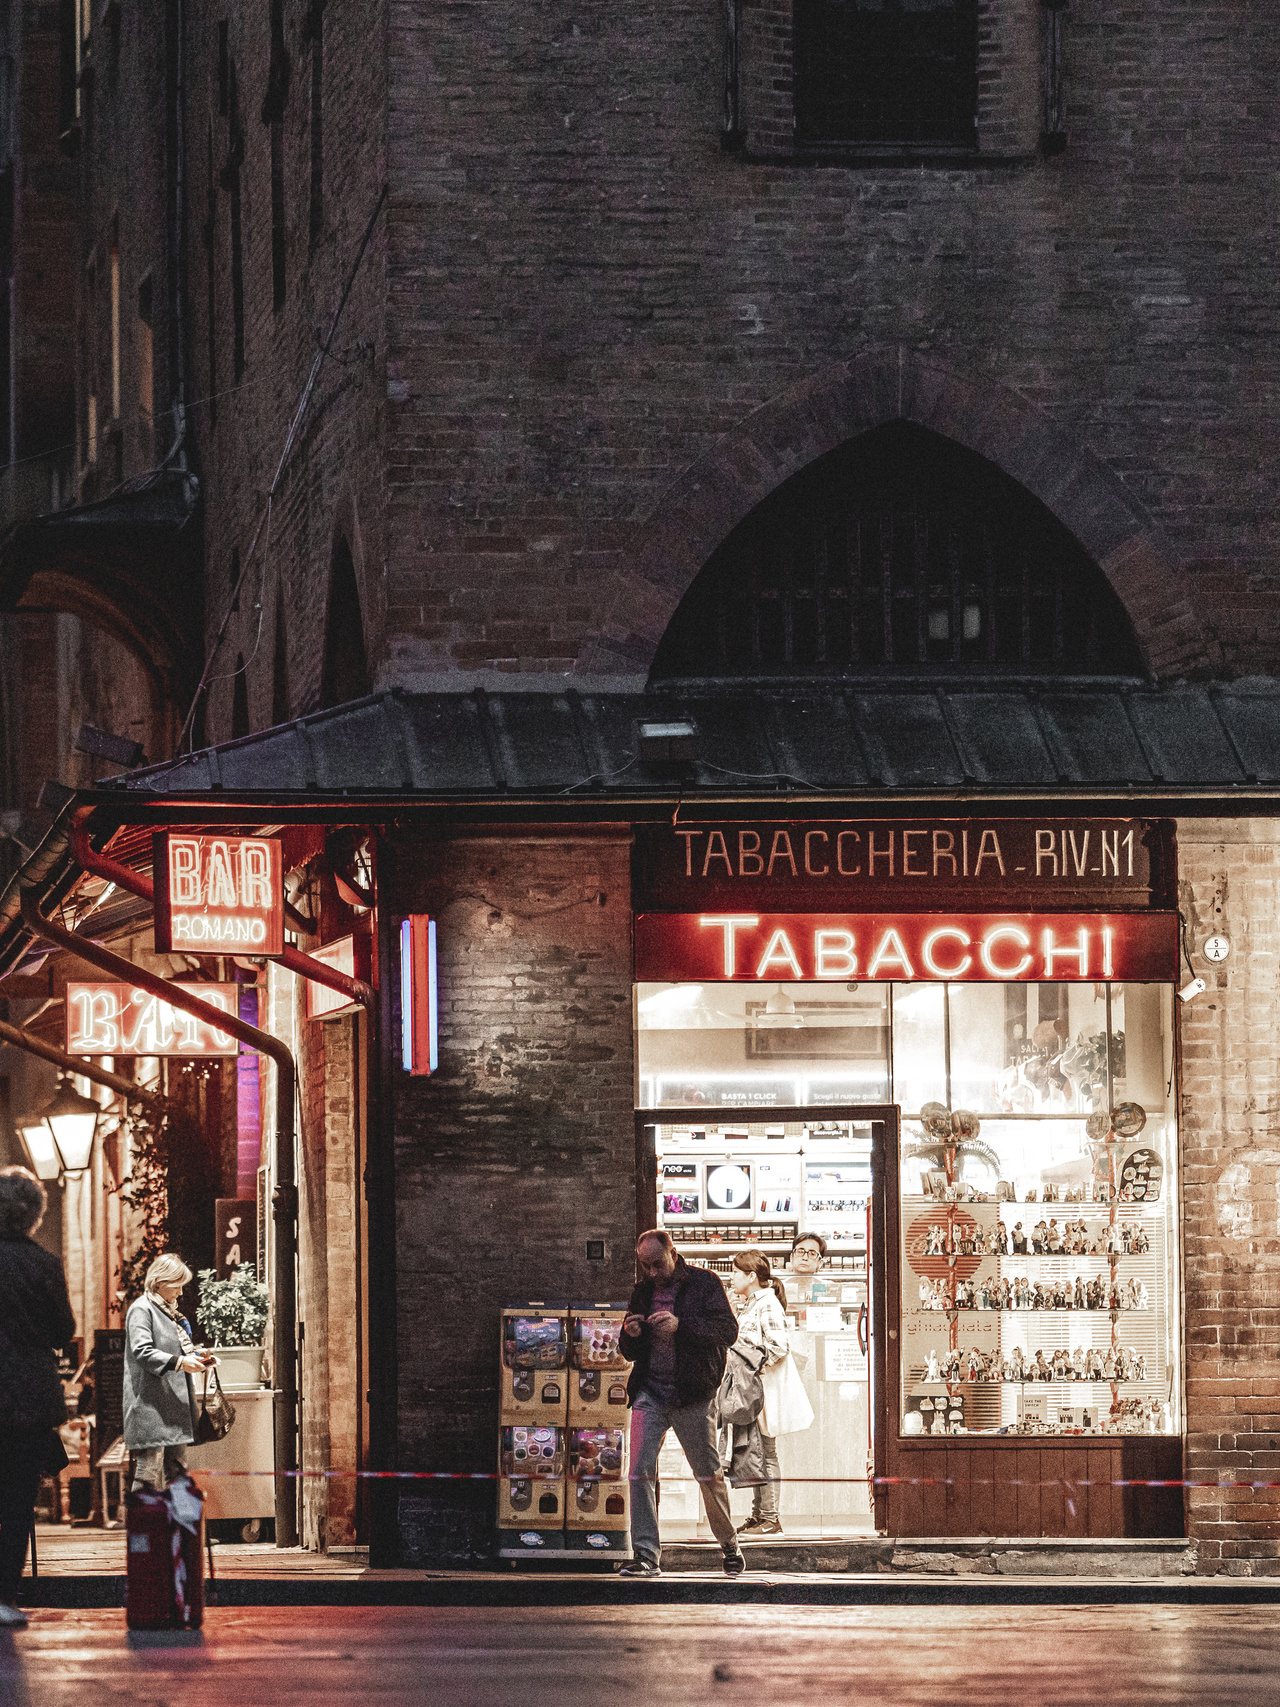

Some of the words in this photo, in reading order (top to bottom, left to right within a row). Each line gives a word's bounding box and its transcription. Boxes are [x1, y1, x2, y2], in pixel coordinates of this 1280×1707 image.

[674, 829, 1006, 877] TABACCHERIA
[168, 840, 273, 908] BAR
[171, 916, 266, 942] ROMANO
[1213, 949, 1220, 958] A
